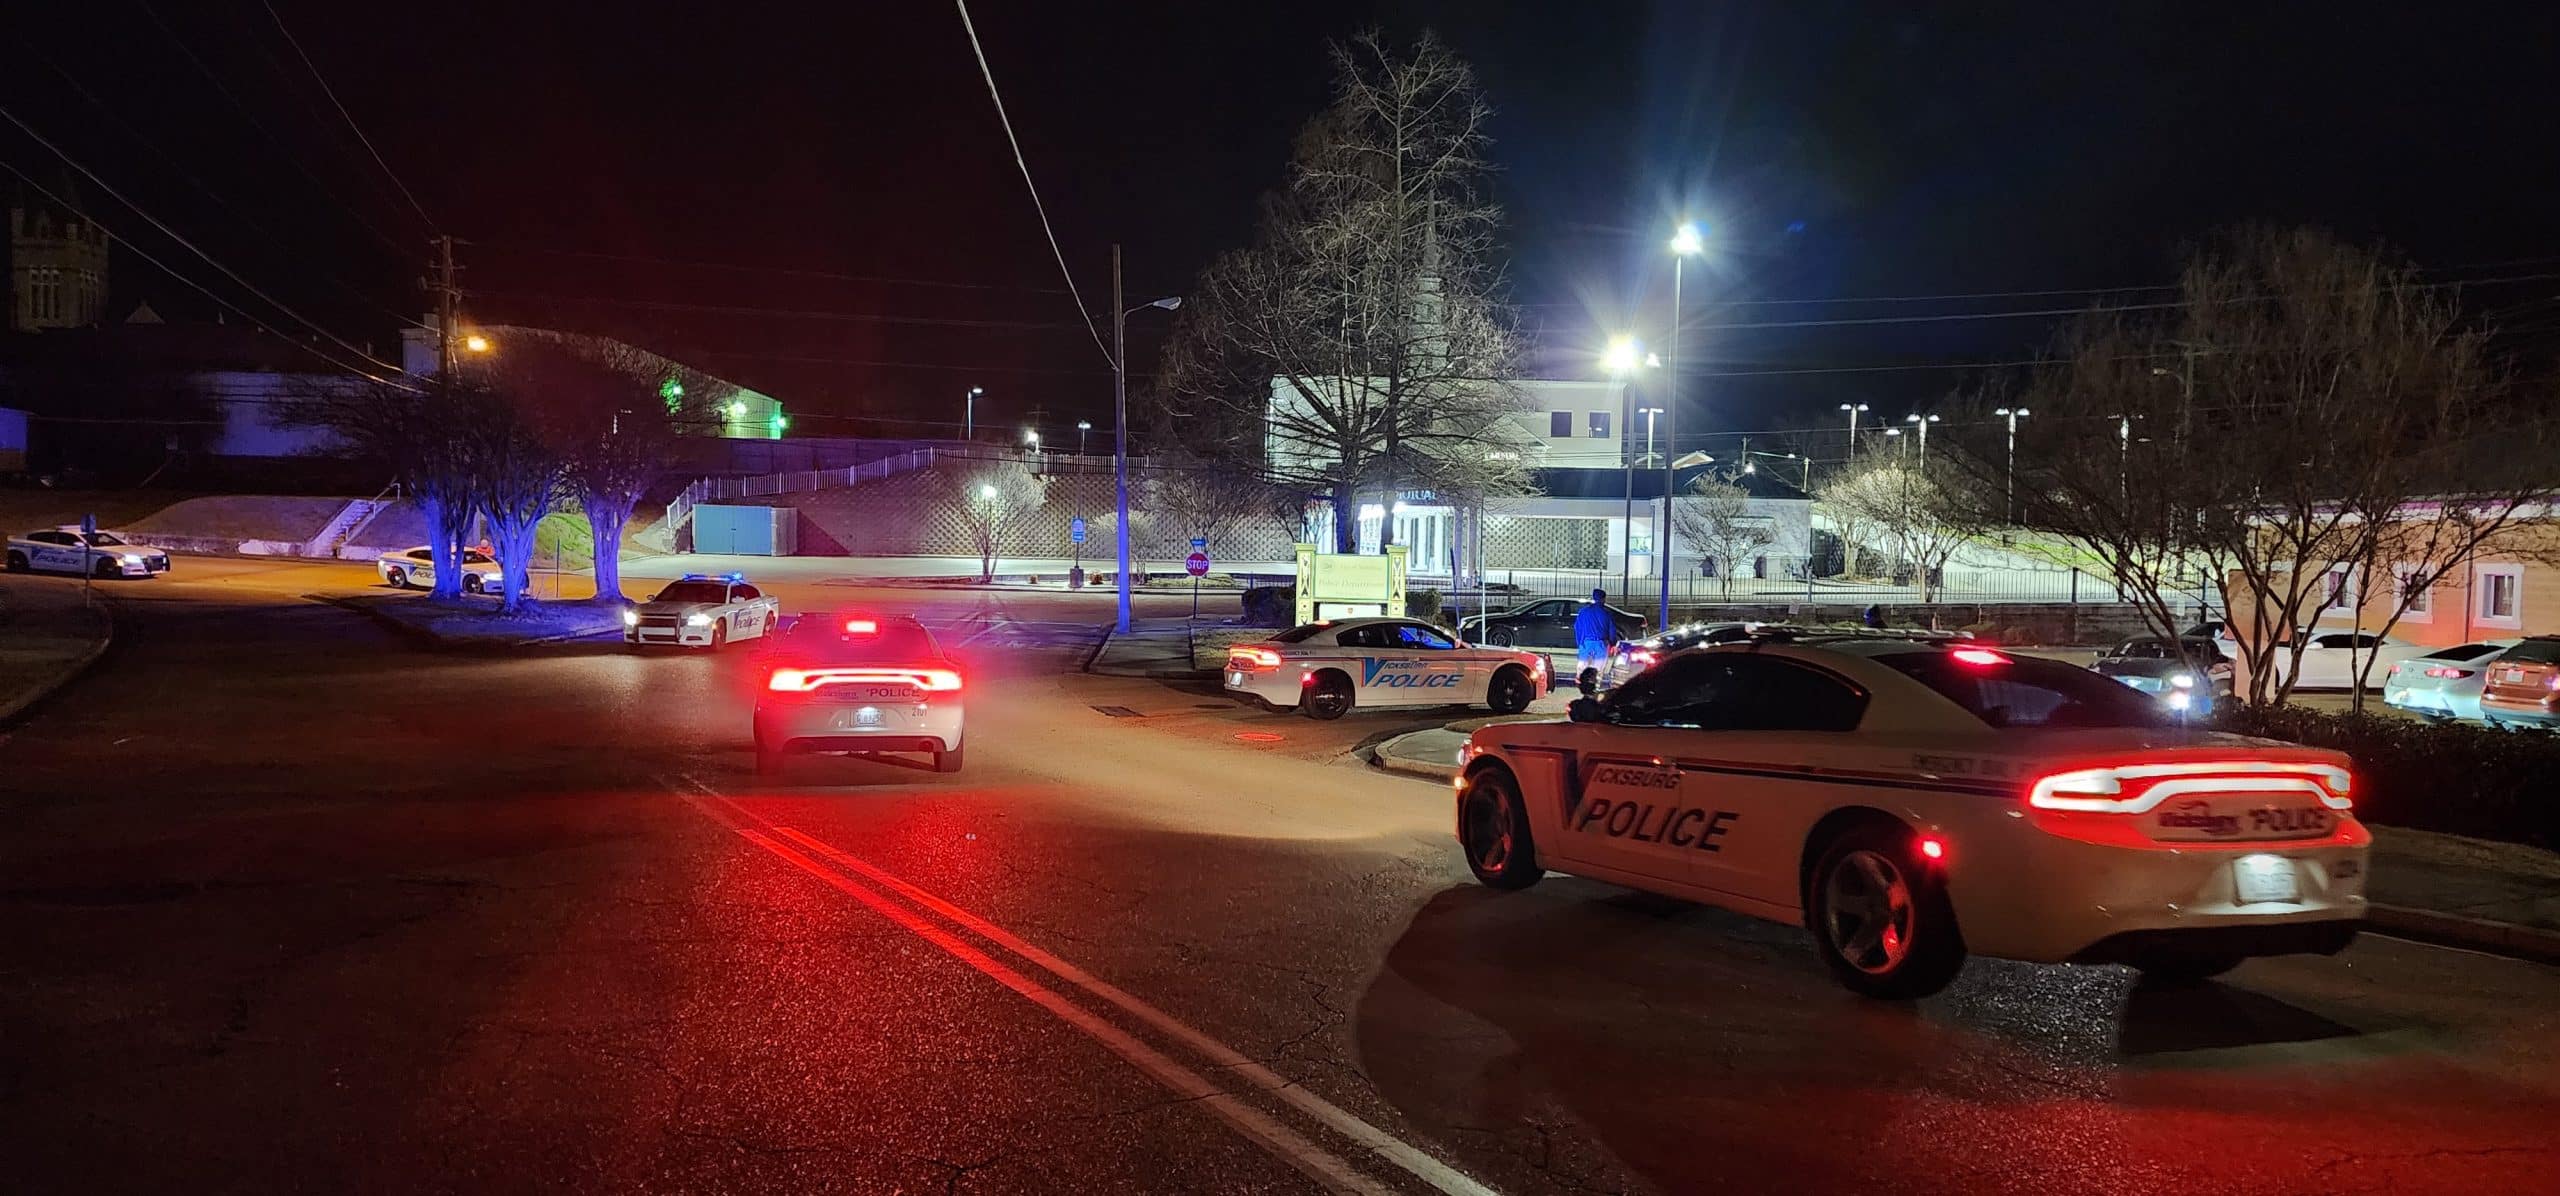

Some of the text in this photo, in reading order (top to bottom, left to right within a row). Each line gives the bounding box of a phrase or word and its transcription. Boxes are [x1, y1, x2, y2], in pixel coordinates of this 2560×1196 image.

[1187, 559, 1208, 569] STOP
[1373, 674, 1464, 687] POLICE
[869, 688, 920, 697] POLICE
[1577, 798, 1741, 852] POLICE
